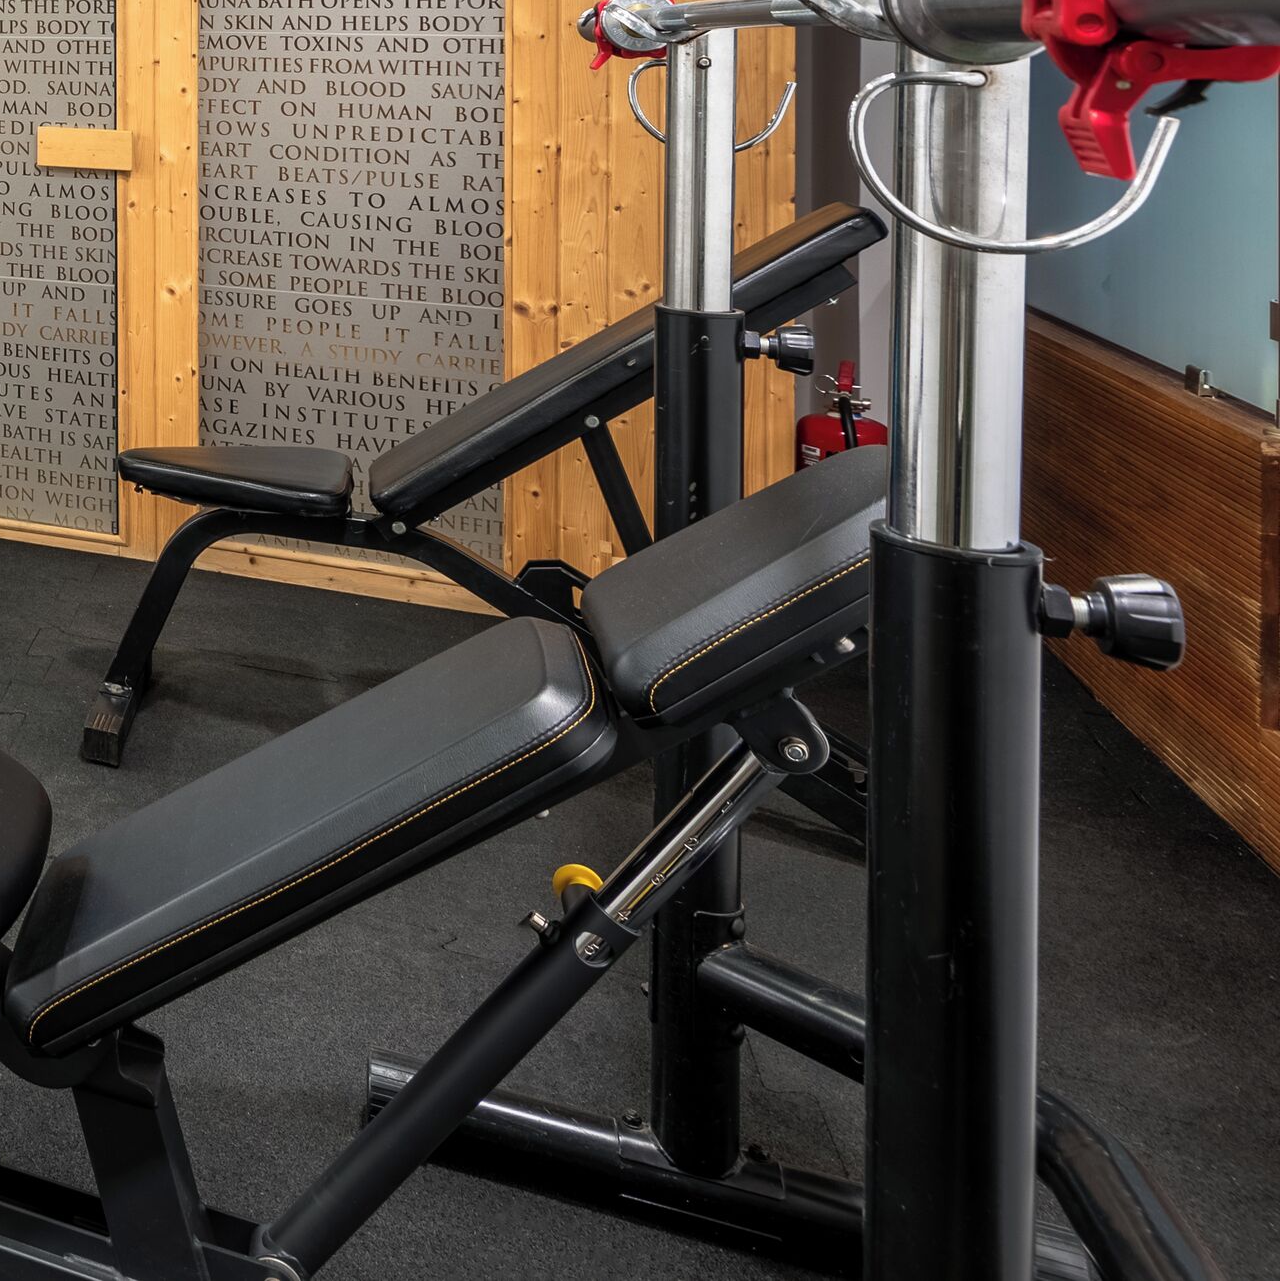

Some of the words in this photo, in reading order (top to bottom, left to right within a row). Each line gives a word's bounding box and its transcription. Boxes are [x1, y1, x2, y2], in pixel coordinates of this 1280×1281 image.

[21, 0, 59, 14] THE
[37, 20, 90, 34] BODY
[224, 15, 273, 30] SKIN
[282, 16, 331, 31] AND
[342, 16, 408, 31] HELPS
[420, 16, 485, 32] BODY
[3, 40, 45, 54] AND
[57, 40, 112, 55] OTHE
[199, 35, 267, 51] EMOVE
[280, 36, 363, 52] TOXINS
[377, 37, 428, 53] AND
[4, 60, 80, 75] WITHIN
[86, 60, 112, 76] TH
[310, 58, 373, 74] FROM
[379, 59, 471, 77] WITHIN
[47, 80, 114, 96] SAUNA'
[257, 79, 306, 95] AND
[326, 81, 406, 98] BLOOD
[68, 102, 112, 117] BOD
[280, 101, 316, 117] ON
[339, 103, 432, 121] HUMAN
[200, 141, 251, 158] EART
[270, 144, 410, 166] CONDITION
[430, 151, 456, 167] AS
[202, 163, 258, 180] EART
[278, 166, 439, 189] BEATS/PULSE
[29, 183, 109, 201] ALMOS
[349, 192, 386, 209] TO
[200, 205, 281, 226] OUBLE,
[300, 211, 412, 233] CAUSING
[435, 220, 504, 238] BLOO
[16, 222, 55, 238] THE
[71, 226, 114, 242] BOD
[199, 226, 330, 250] IRCULATION
[349, 236, 374, 253] IN
[393, 239, 439, 257] THE
[29, 244, 68, 260] THE
[7, 262, 44, 279] THE
[290, 254, 400, 277] TOWARDS
[409, 262, 455, 281] THE
[464, 266, 499, 284] SKI
[2, 281, 27, 296] UP
[42, 286, 85, 302] AND
[219, 271, 276, 290] SOME
[290, 276, 368, 297] PEOPLE
[381, 282, 427, 301] THE
[442, 288, 504, 307] BLOO
[13, 302, 34, 318] IT
[295, 298, 353, 317] GOES
[372, 304, 401, 320] UP
[419, 309, 472, 327] AND
[267, 317, 361, 339] PEOPLE
[385, 327, 410, 343] IT
[4, 342, 90, 365] BENEFITS
[200, 332, 287, 355] OWEVER,
[301, 342, 313, 357] A
[329, 344, 402, 366] STUDY
[416, 352, 500, 376] CARRIE
[230, 357, 263, 374] ON
[275, 362, 360, 385] HEALTH
[373, 372, 477, 397] BENEFITS
[202, 375, 246, 394] UNA
[266, 381, 290, 398] BY
[307, 386, 406, 412] VARIOUS
[200, 396, 239, 414] ASE
[3, 424, 53, 444] BATH
[60, 431, 76, 446] IS
[83, 434, 114, 450] SAF
[200, 418, 315, 445] AGAZINES
